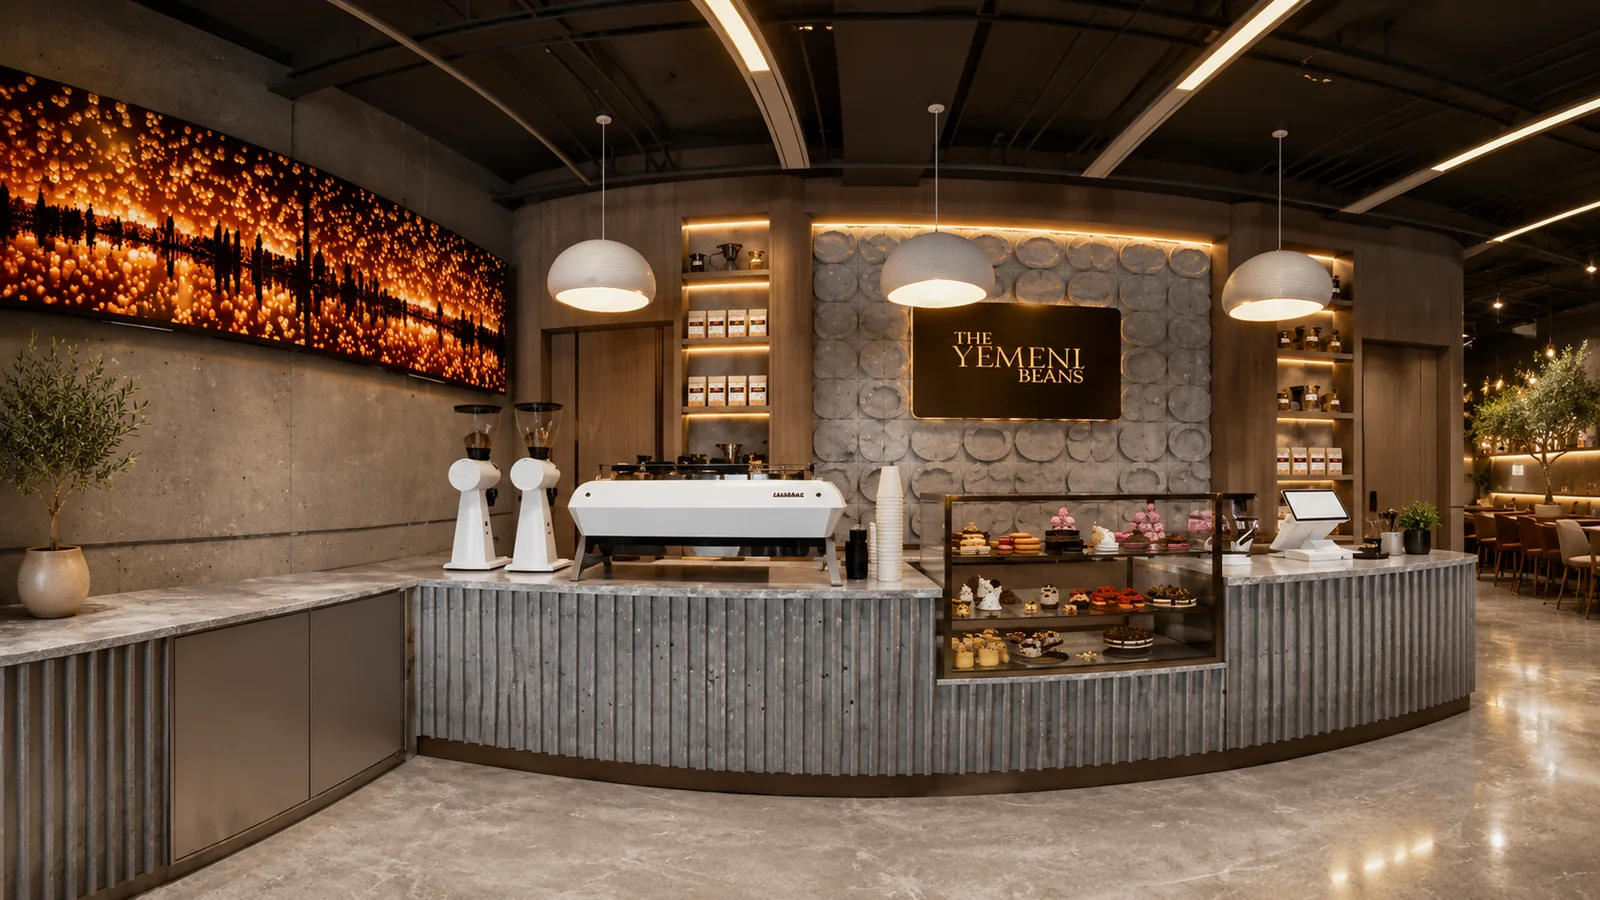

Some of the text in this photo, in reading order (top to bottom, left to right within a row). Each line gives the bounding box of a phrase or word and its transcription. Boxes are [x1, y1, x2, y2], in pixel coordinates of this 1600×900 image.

[953, 331, 992, 345] THE
[952, 345, 1085, 369] YEMENI
[1018, 369, 1084, 384] BEANS
